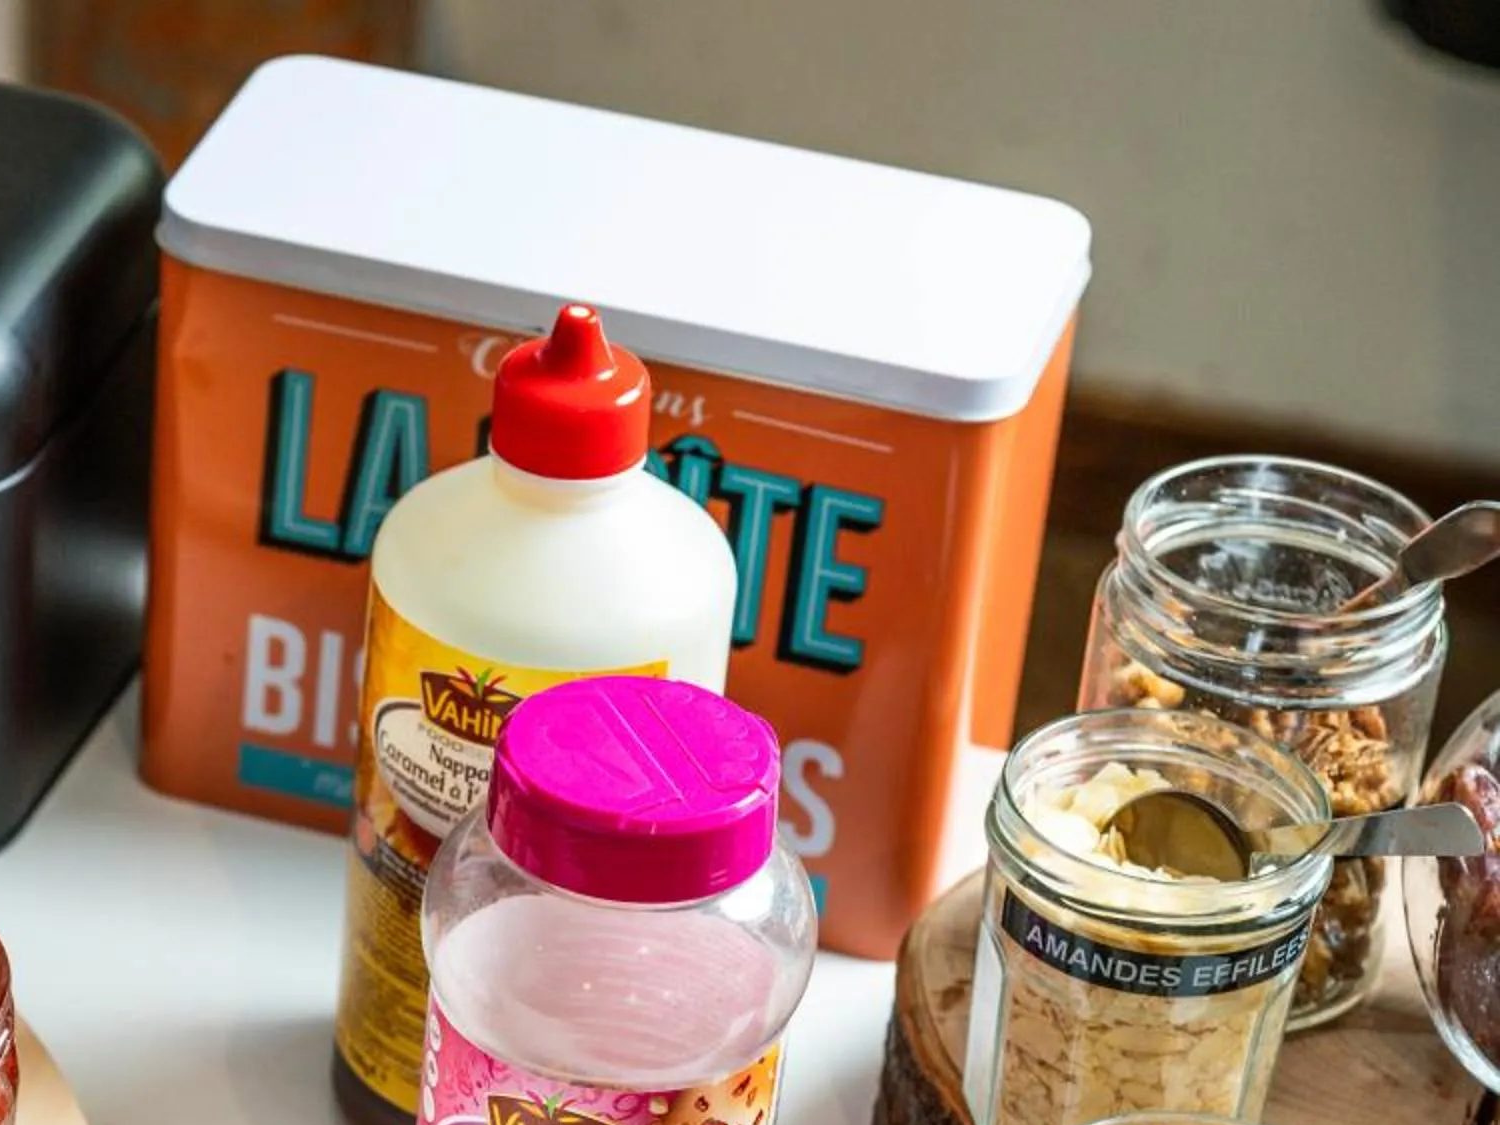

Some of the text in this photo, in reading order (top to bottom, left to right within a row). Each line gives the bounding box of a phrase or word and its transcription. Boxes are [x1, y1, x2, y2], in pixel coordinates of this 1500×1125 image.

[255, 366, 428, 566] LA
[379, 728, 446, 794] Caramel
[428, 742, 489, 783] Nappa
[1026, 923, 1310, 988] AMANDES EFFILEES
